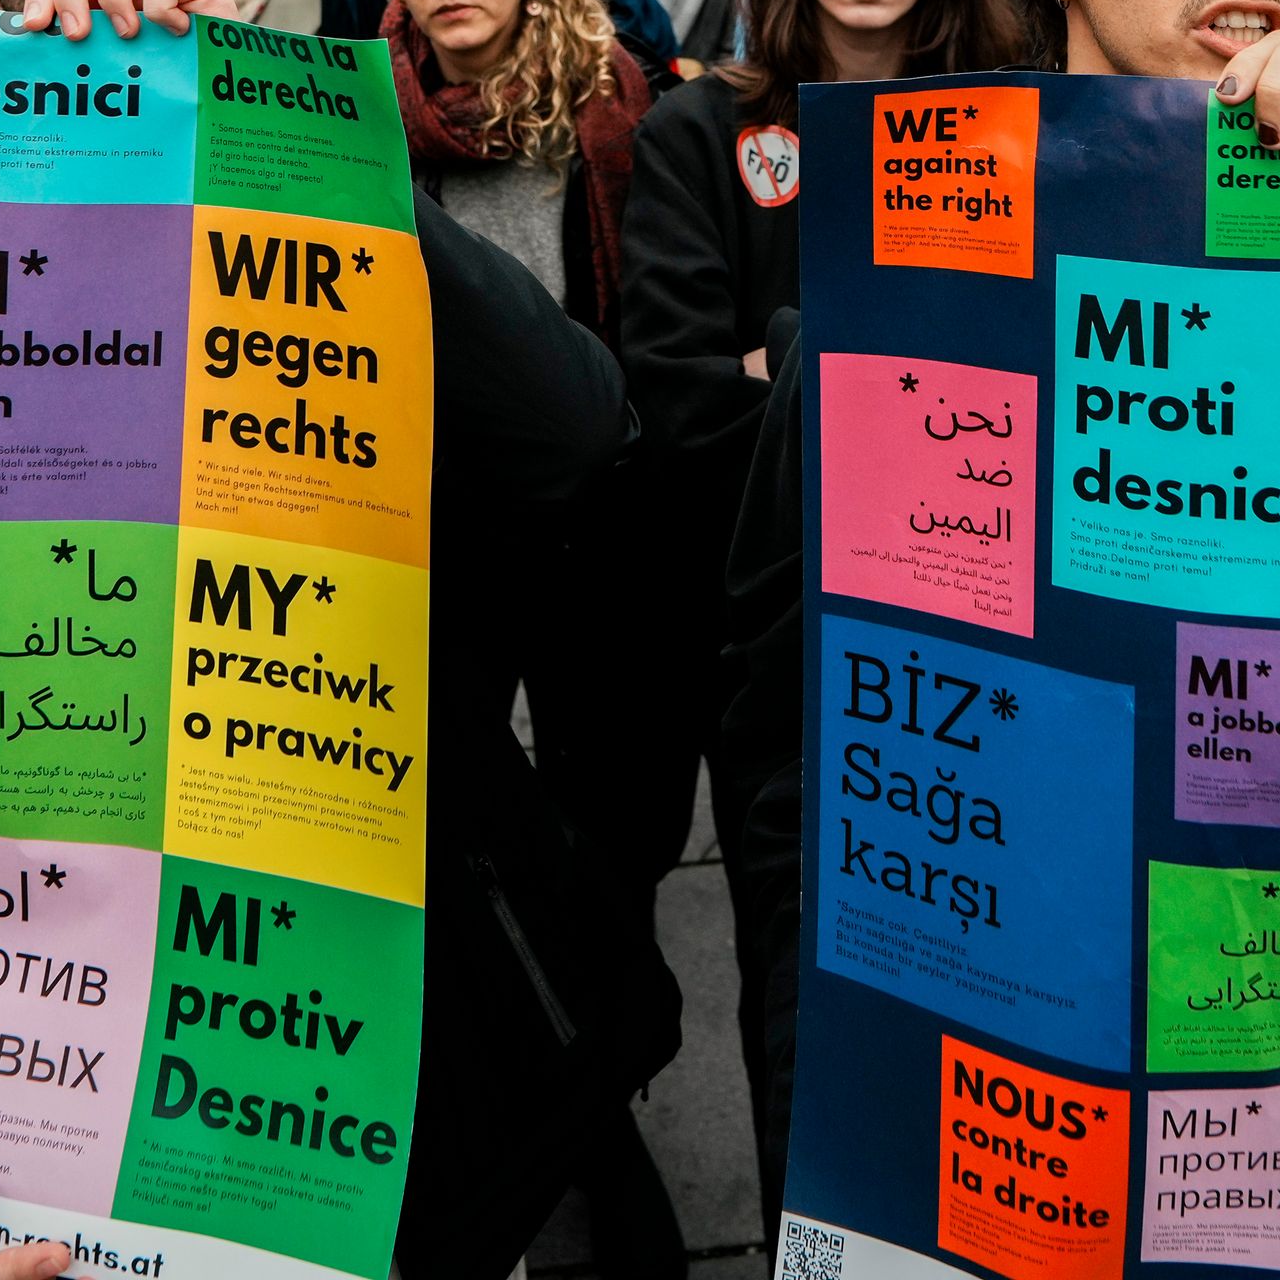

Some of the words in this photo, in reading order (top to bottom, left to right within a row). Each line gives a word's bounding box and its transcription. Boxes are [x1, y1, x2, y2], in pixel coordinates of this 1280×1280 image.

[212, 60, 359, 121] derecha
[884, 155, 996, 181] against
[884, 185, 932, 210] the
[943, 187, 1012, 221] right
[205, 327, 377, 388] gegen
[202, 399, 376, 468] rechts
[1076, 382, 1234, 435] proti
[957, 459, 1012, 487] ضد
[188, 648, 394, 712] przeciwk
[1188, 712, 1204, 726] a
[1188, 737, 1251, 763] ellen
[184, 713, 211, 739] o
[226, 719, 414, 792] prawicy
[842, 743, 1005, 846] Sağa
[840, 818, 1001, 933] karşı
[165, 984, 364, 1056] protiv
[152, 1054, 396, 1164] Desnice
[952, 1120, 1068, 1184] contre
[952, 1152, 982, 1194] la
[994, 1176, 1109, 1228] droite
